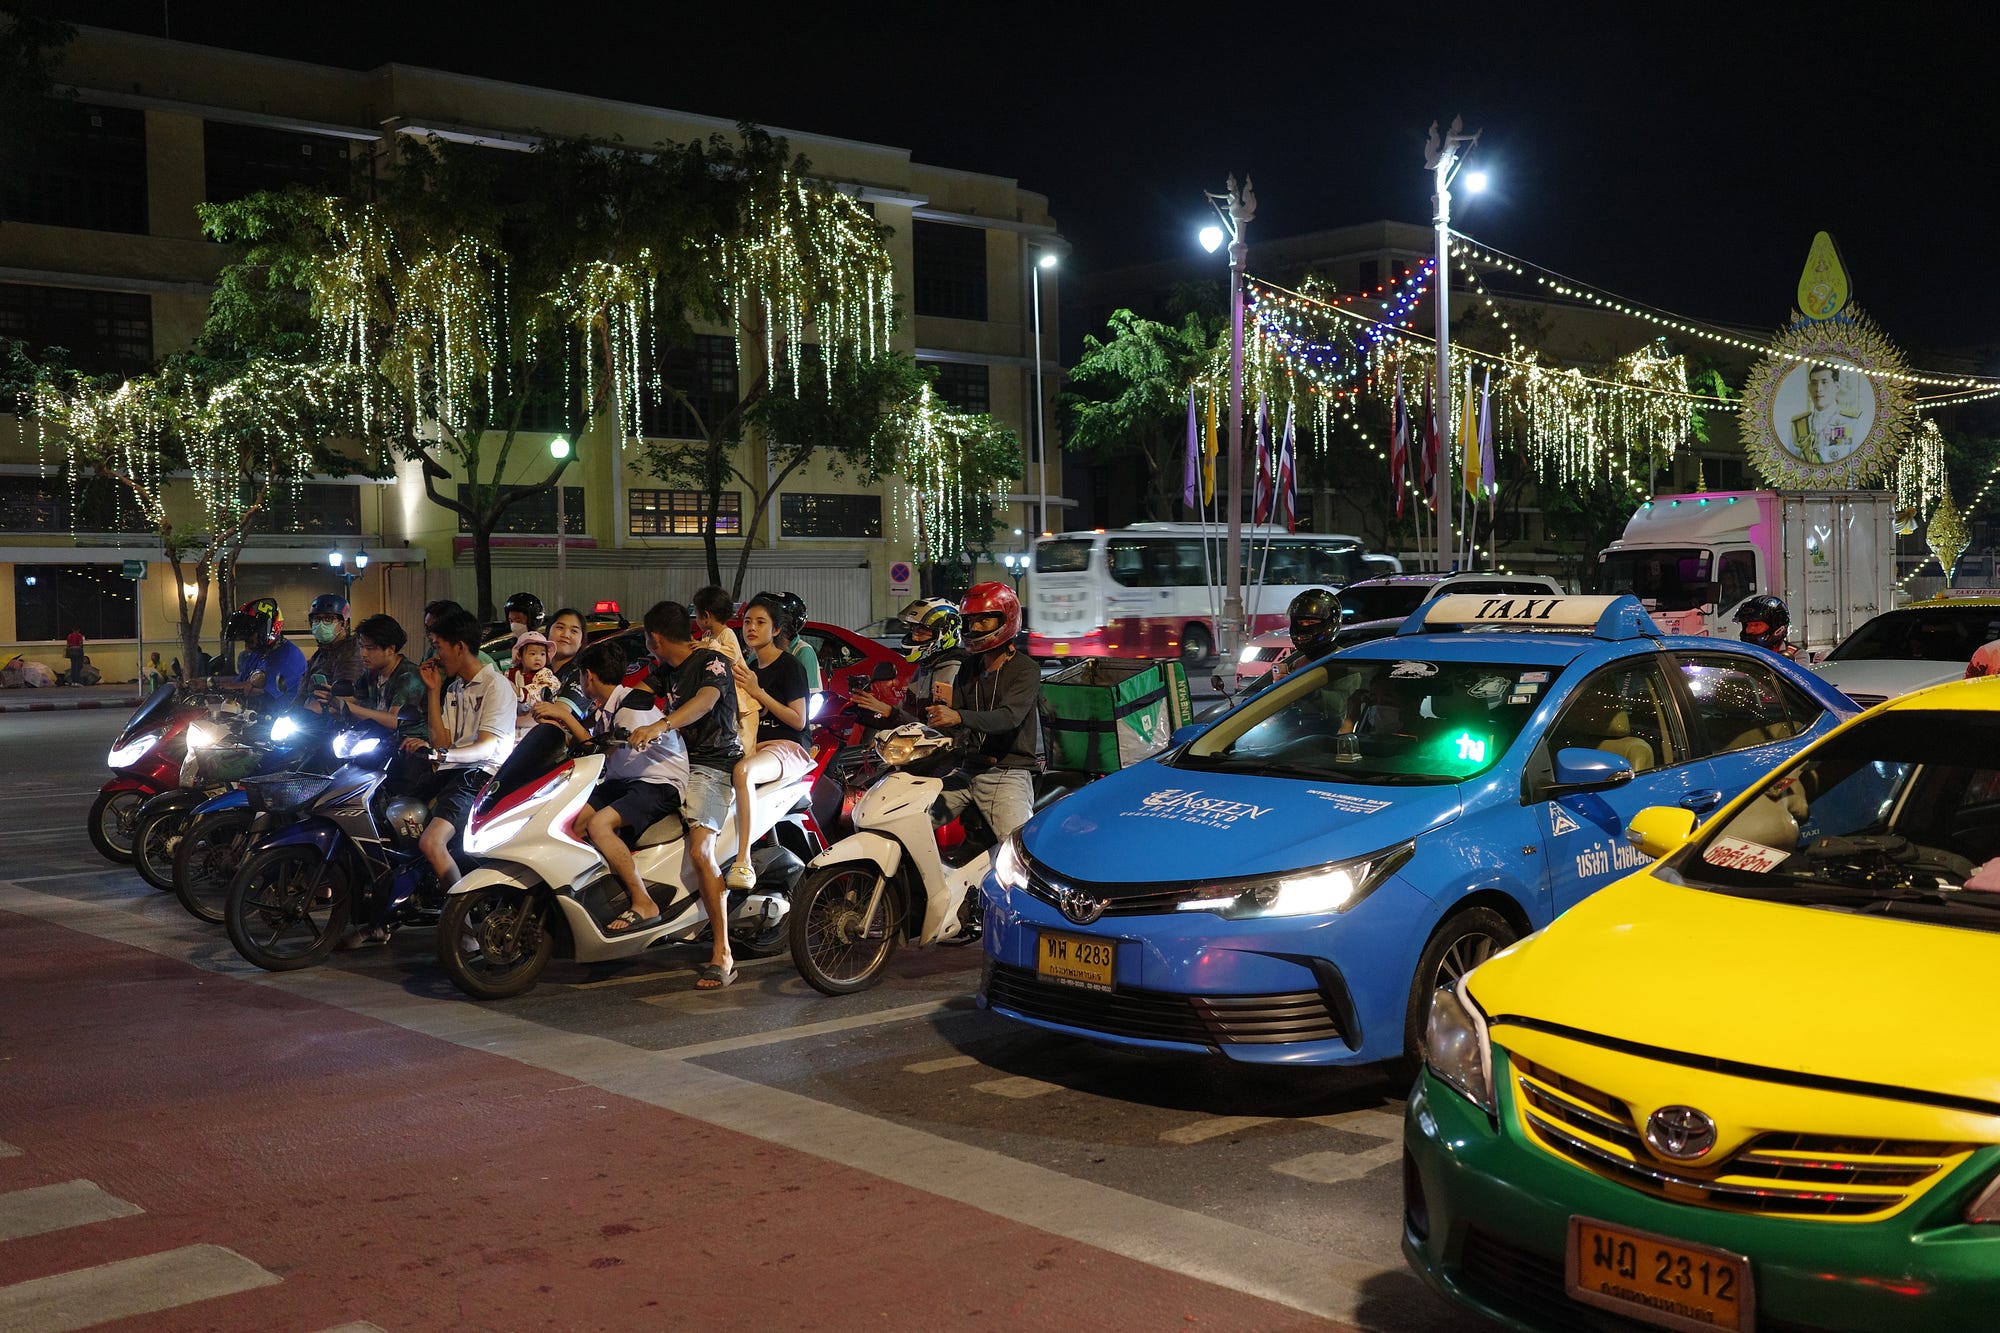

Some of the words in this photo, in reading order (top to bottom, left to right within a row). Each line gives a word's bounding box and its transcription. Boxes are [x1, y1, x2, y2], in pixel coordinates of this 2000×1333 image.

[1475, 599, 1564, 619] TAXI
[1138, 805, 1239, 823] THAILAND
[1142, 789, 1274, 820] UNSEEN
[1801, 828, 1820, 839] TAXI
[1575, 842, 1610, 879] บริษัท
[1075, 943, 1110, 966] 4283
[1654, 1250, 1736, 1302] 2312
